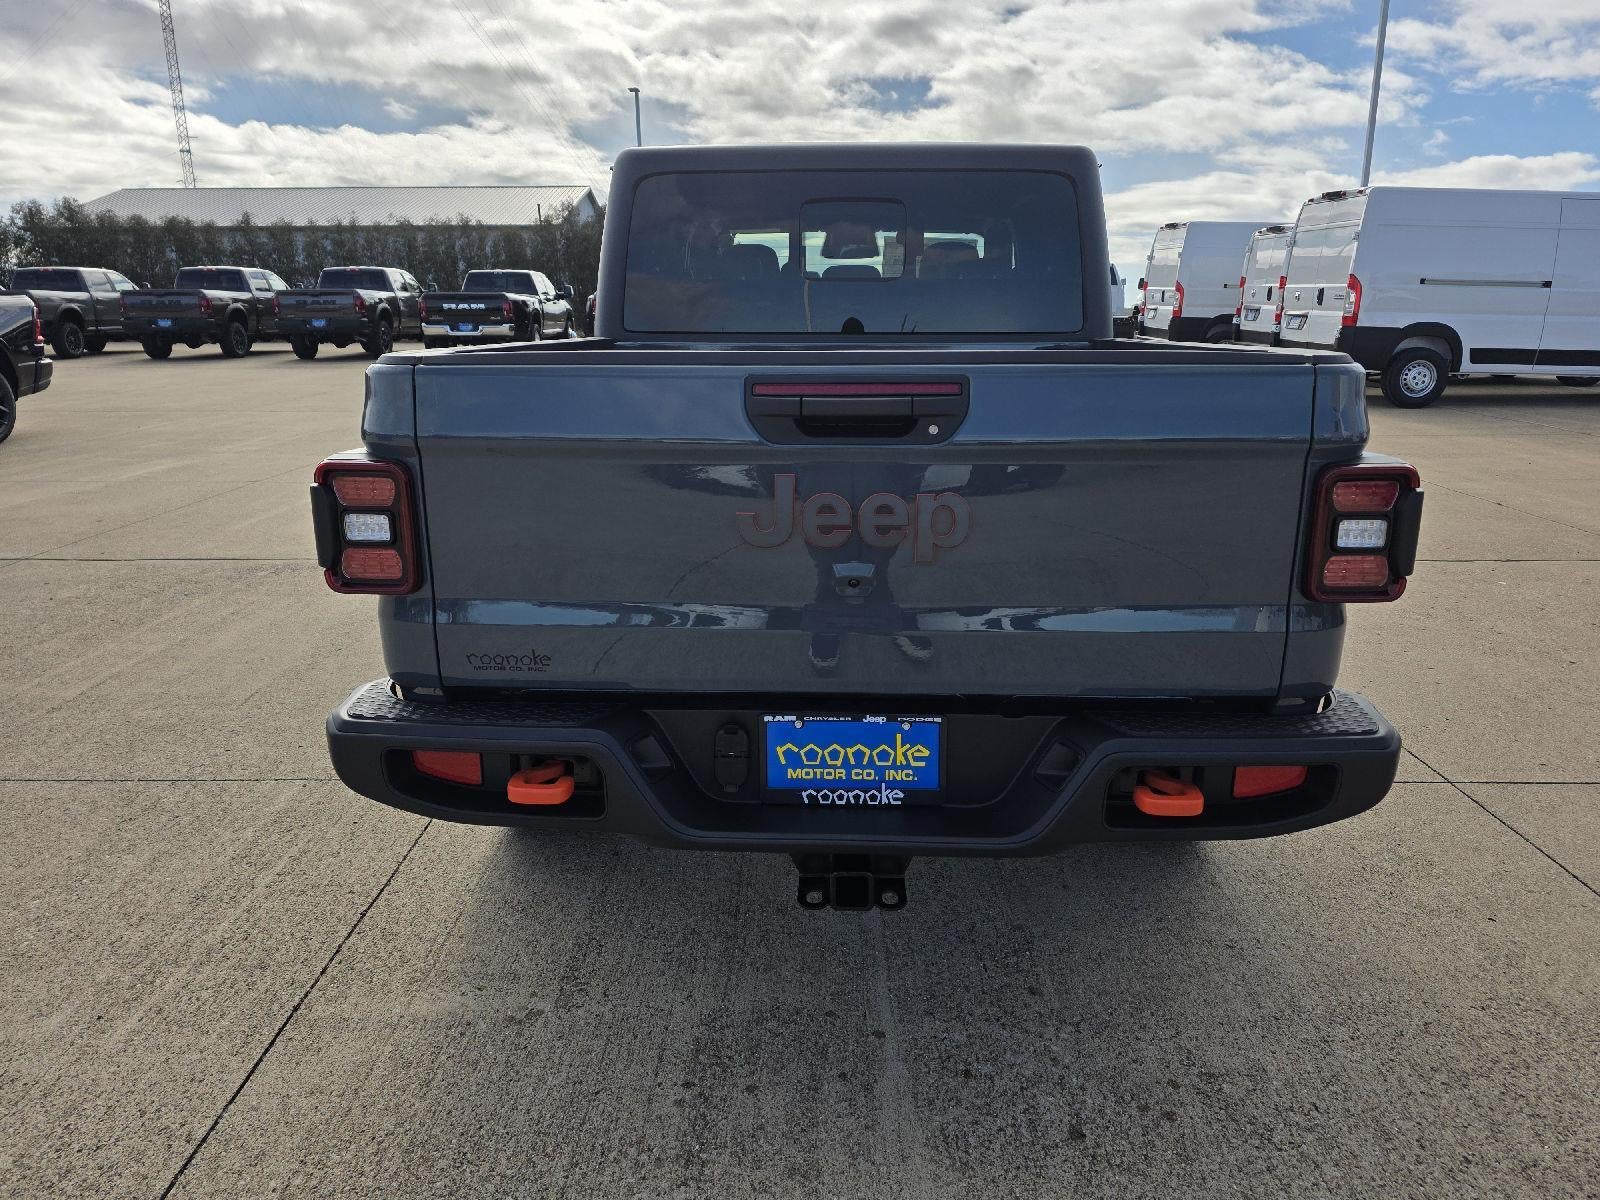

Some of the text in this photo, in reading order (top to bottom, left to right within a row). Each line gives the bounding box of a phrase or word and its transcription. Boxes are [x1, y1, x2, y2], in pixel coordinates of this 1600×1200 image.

[735, 472, 975, 565] Jeep
[862, 714, 887, 725] Jeep
[787, 768, 918, 781] MOTOR CO. INC.
